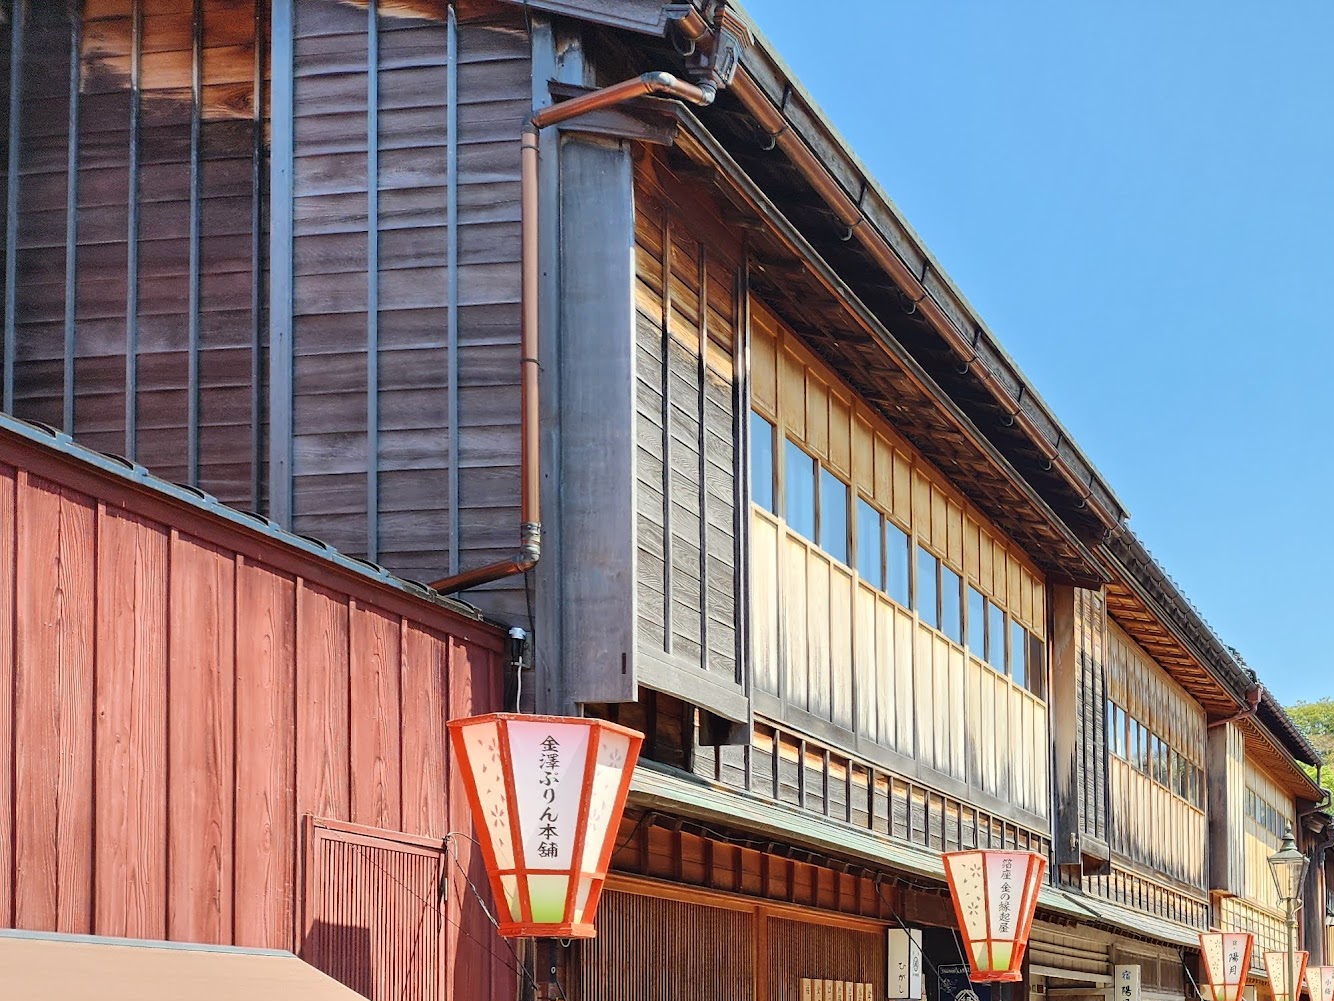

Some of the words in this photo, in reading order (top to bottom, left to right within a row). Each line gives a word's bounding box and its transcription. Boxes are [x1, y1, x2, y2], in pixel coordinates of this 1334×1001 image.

[537, 735, 561, 858] 金澤ぷりん本舗
[898, 962, 907, 994] ひがし
